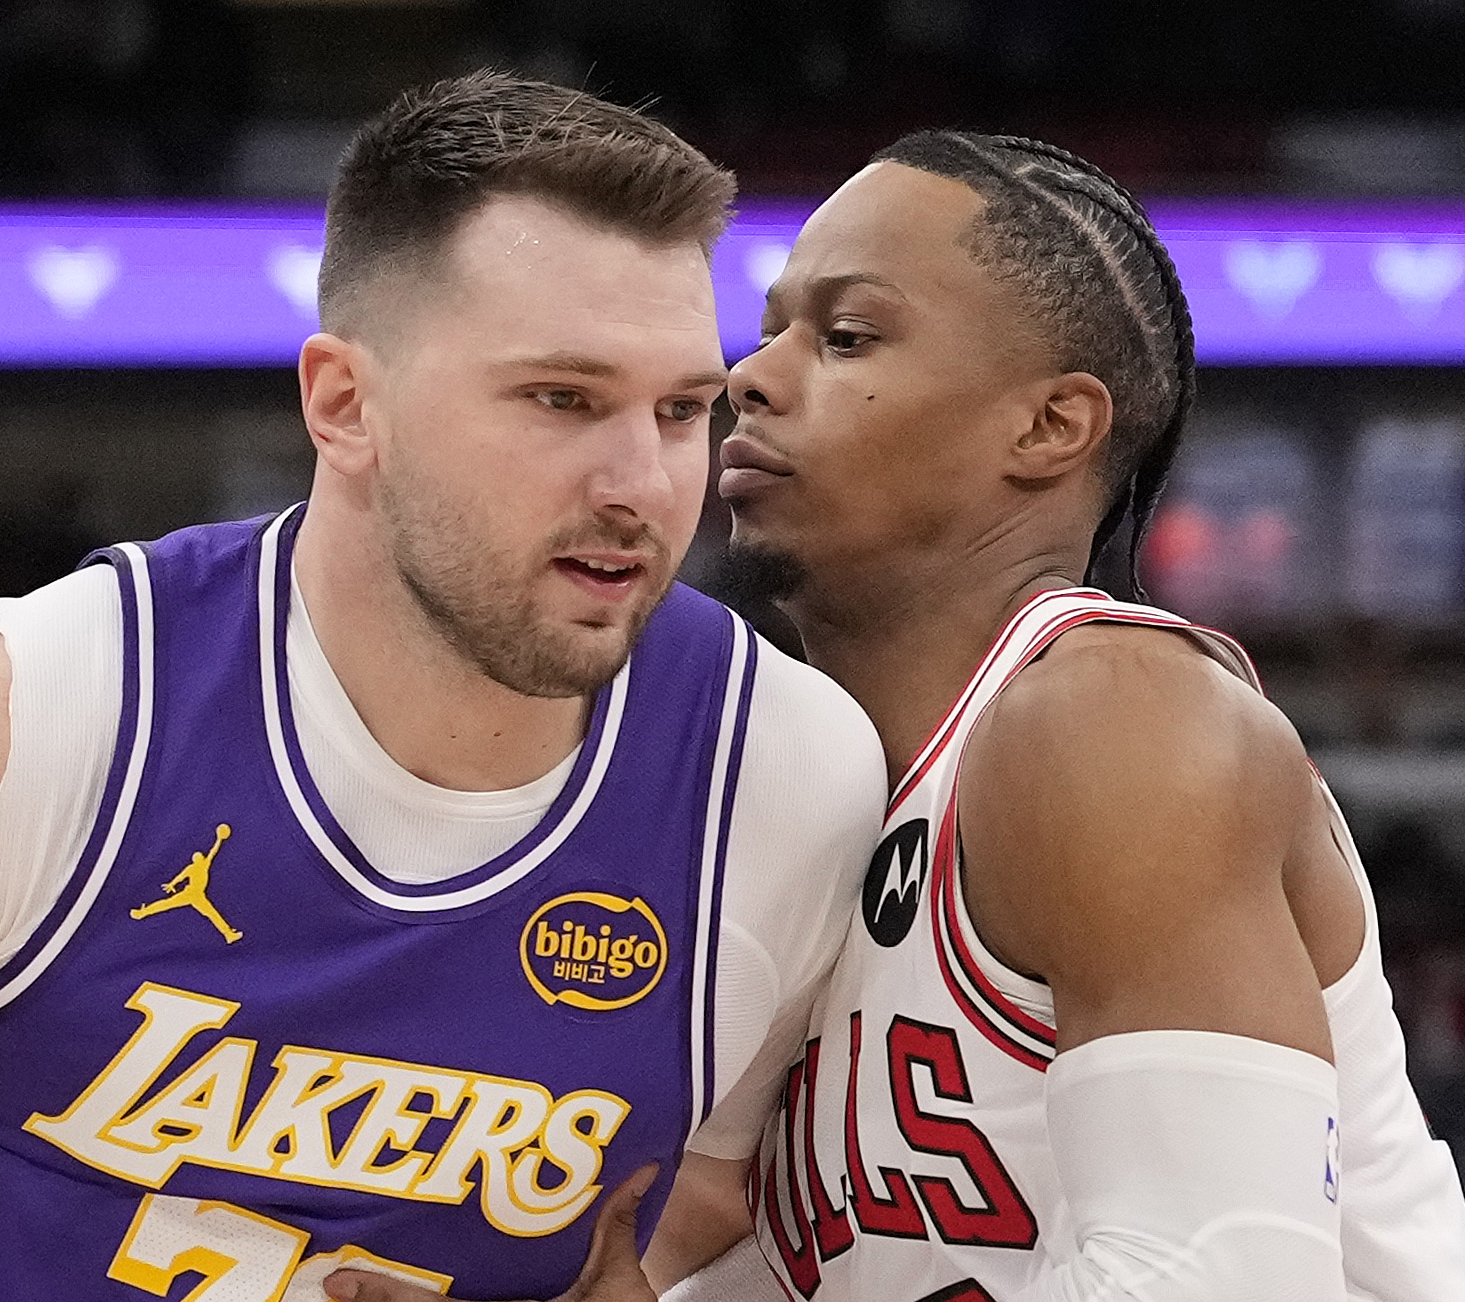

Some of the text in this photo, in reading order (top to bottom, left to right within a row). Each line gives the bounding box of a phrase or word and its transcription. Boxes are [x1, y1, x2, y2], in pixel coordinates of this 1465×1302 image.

[535, 920, 658, 978] bibigo
[553, 961, 605, 984] 비비고
[23, 982, 633, 1238] LAKERS
[746, 1009, 1039, 1300] ULLS
